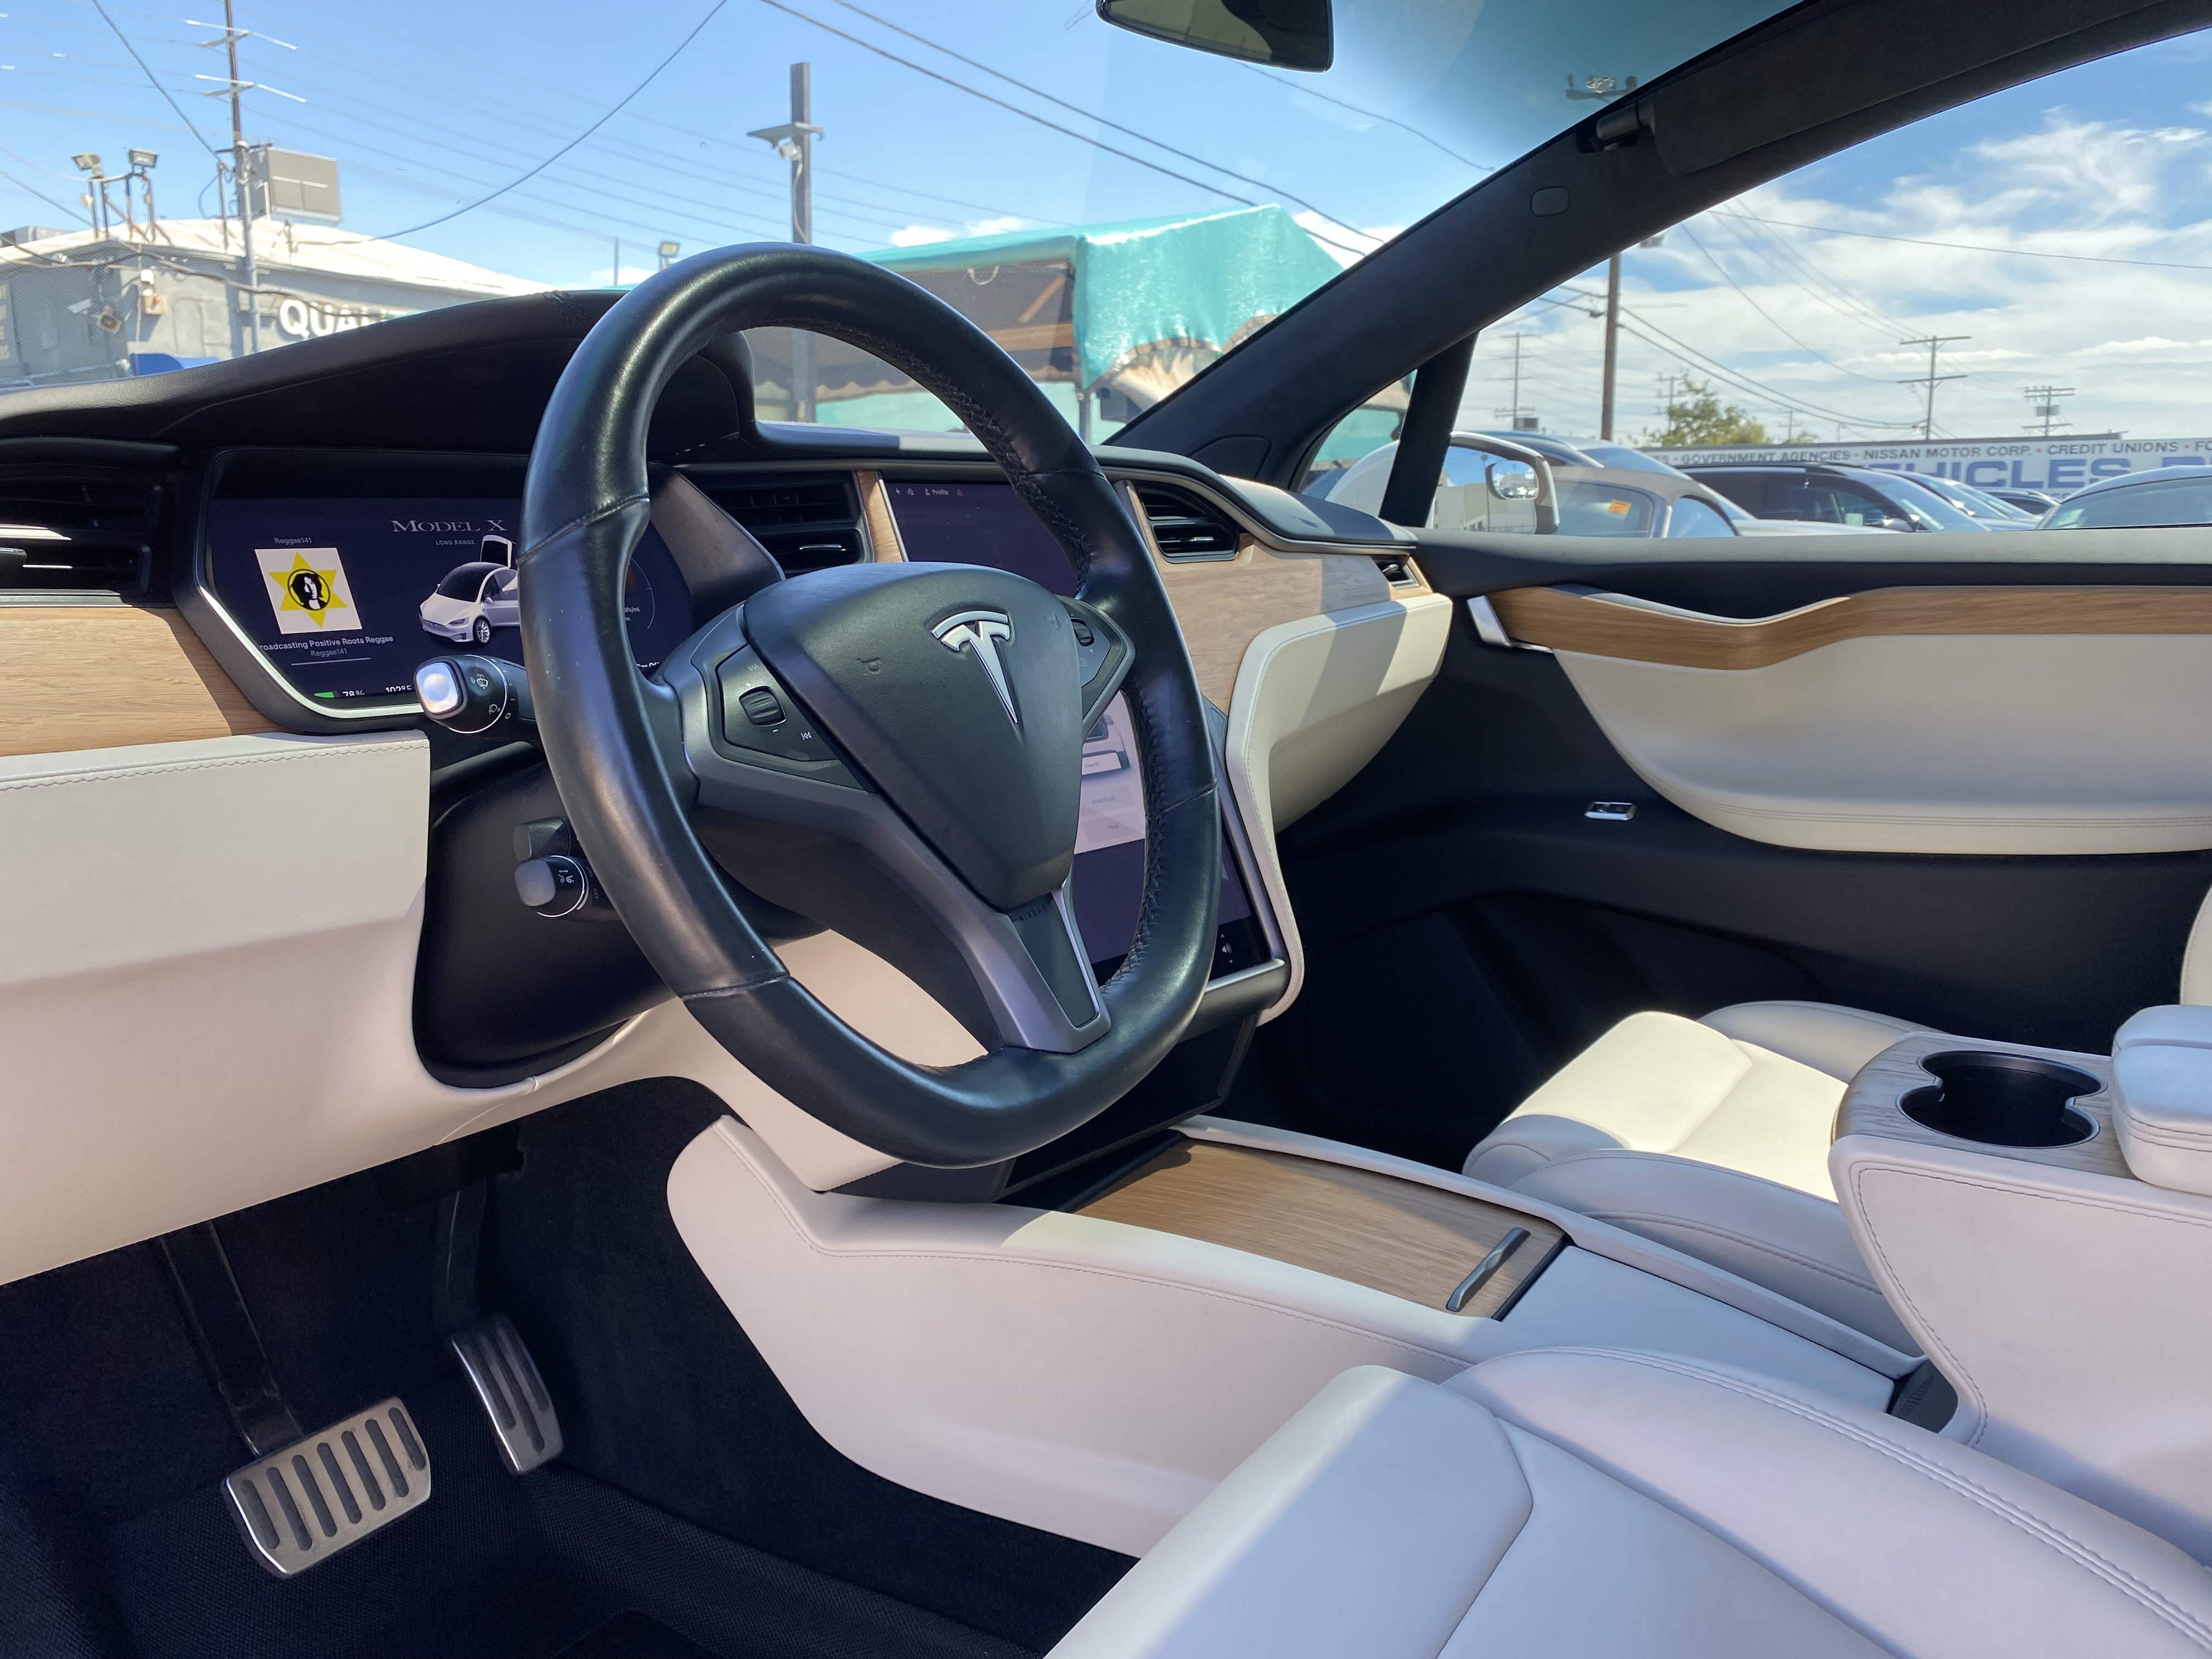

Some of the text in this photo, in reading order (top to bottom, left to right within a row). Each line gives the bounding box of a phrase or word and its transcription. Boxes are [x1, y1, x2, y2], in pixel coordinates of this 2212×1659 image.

[1682, 452, 1776, 465] GOVERNMENT
[1781, 450, 1850, 462] AGENCIES
[1864, 449, 1920, 460] NISSAN
[1926, 446, 1981, 458] MOTOR
[1987, 445, 2031, 456] CORP.
[2047, 443, 2108, 455] CREDIT
[2113, 441, 2179, 454] UNIONS
[486, 520, 508, 531] X
[274, 537, 313, 545] Reggae141
[259, 641, 308, 651] roadcasting
[308, 639, 341, 648] Positive
[365, 635, 394, 644] Reggae
[310, 648, 348, 658] Reggae141
[1019, 904, 1047, 922] AIRBAG
